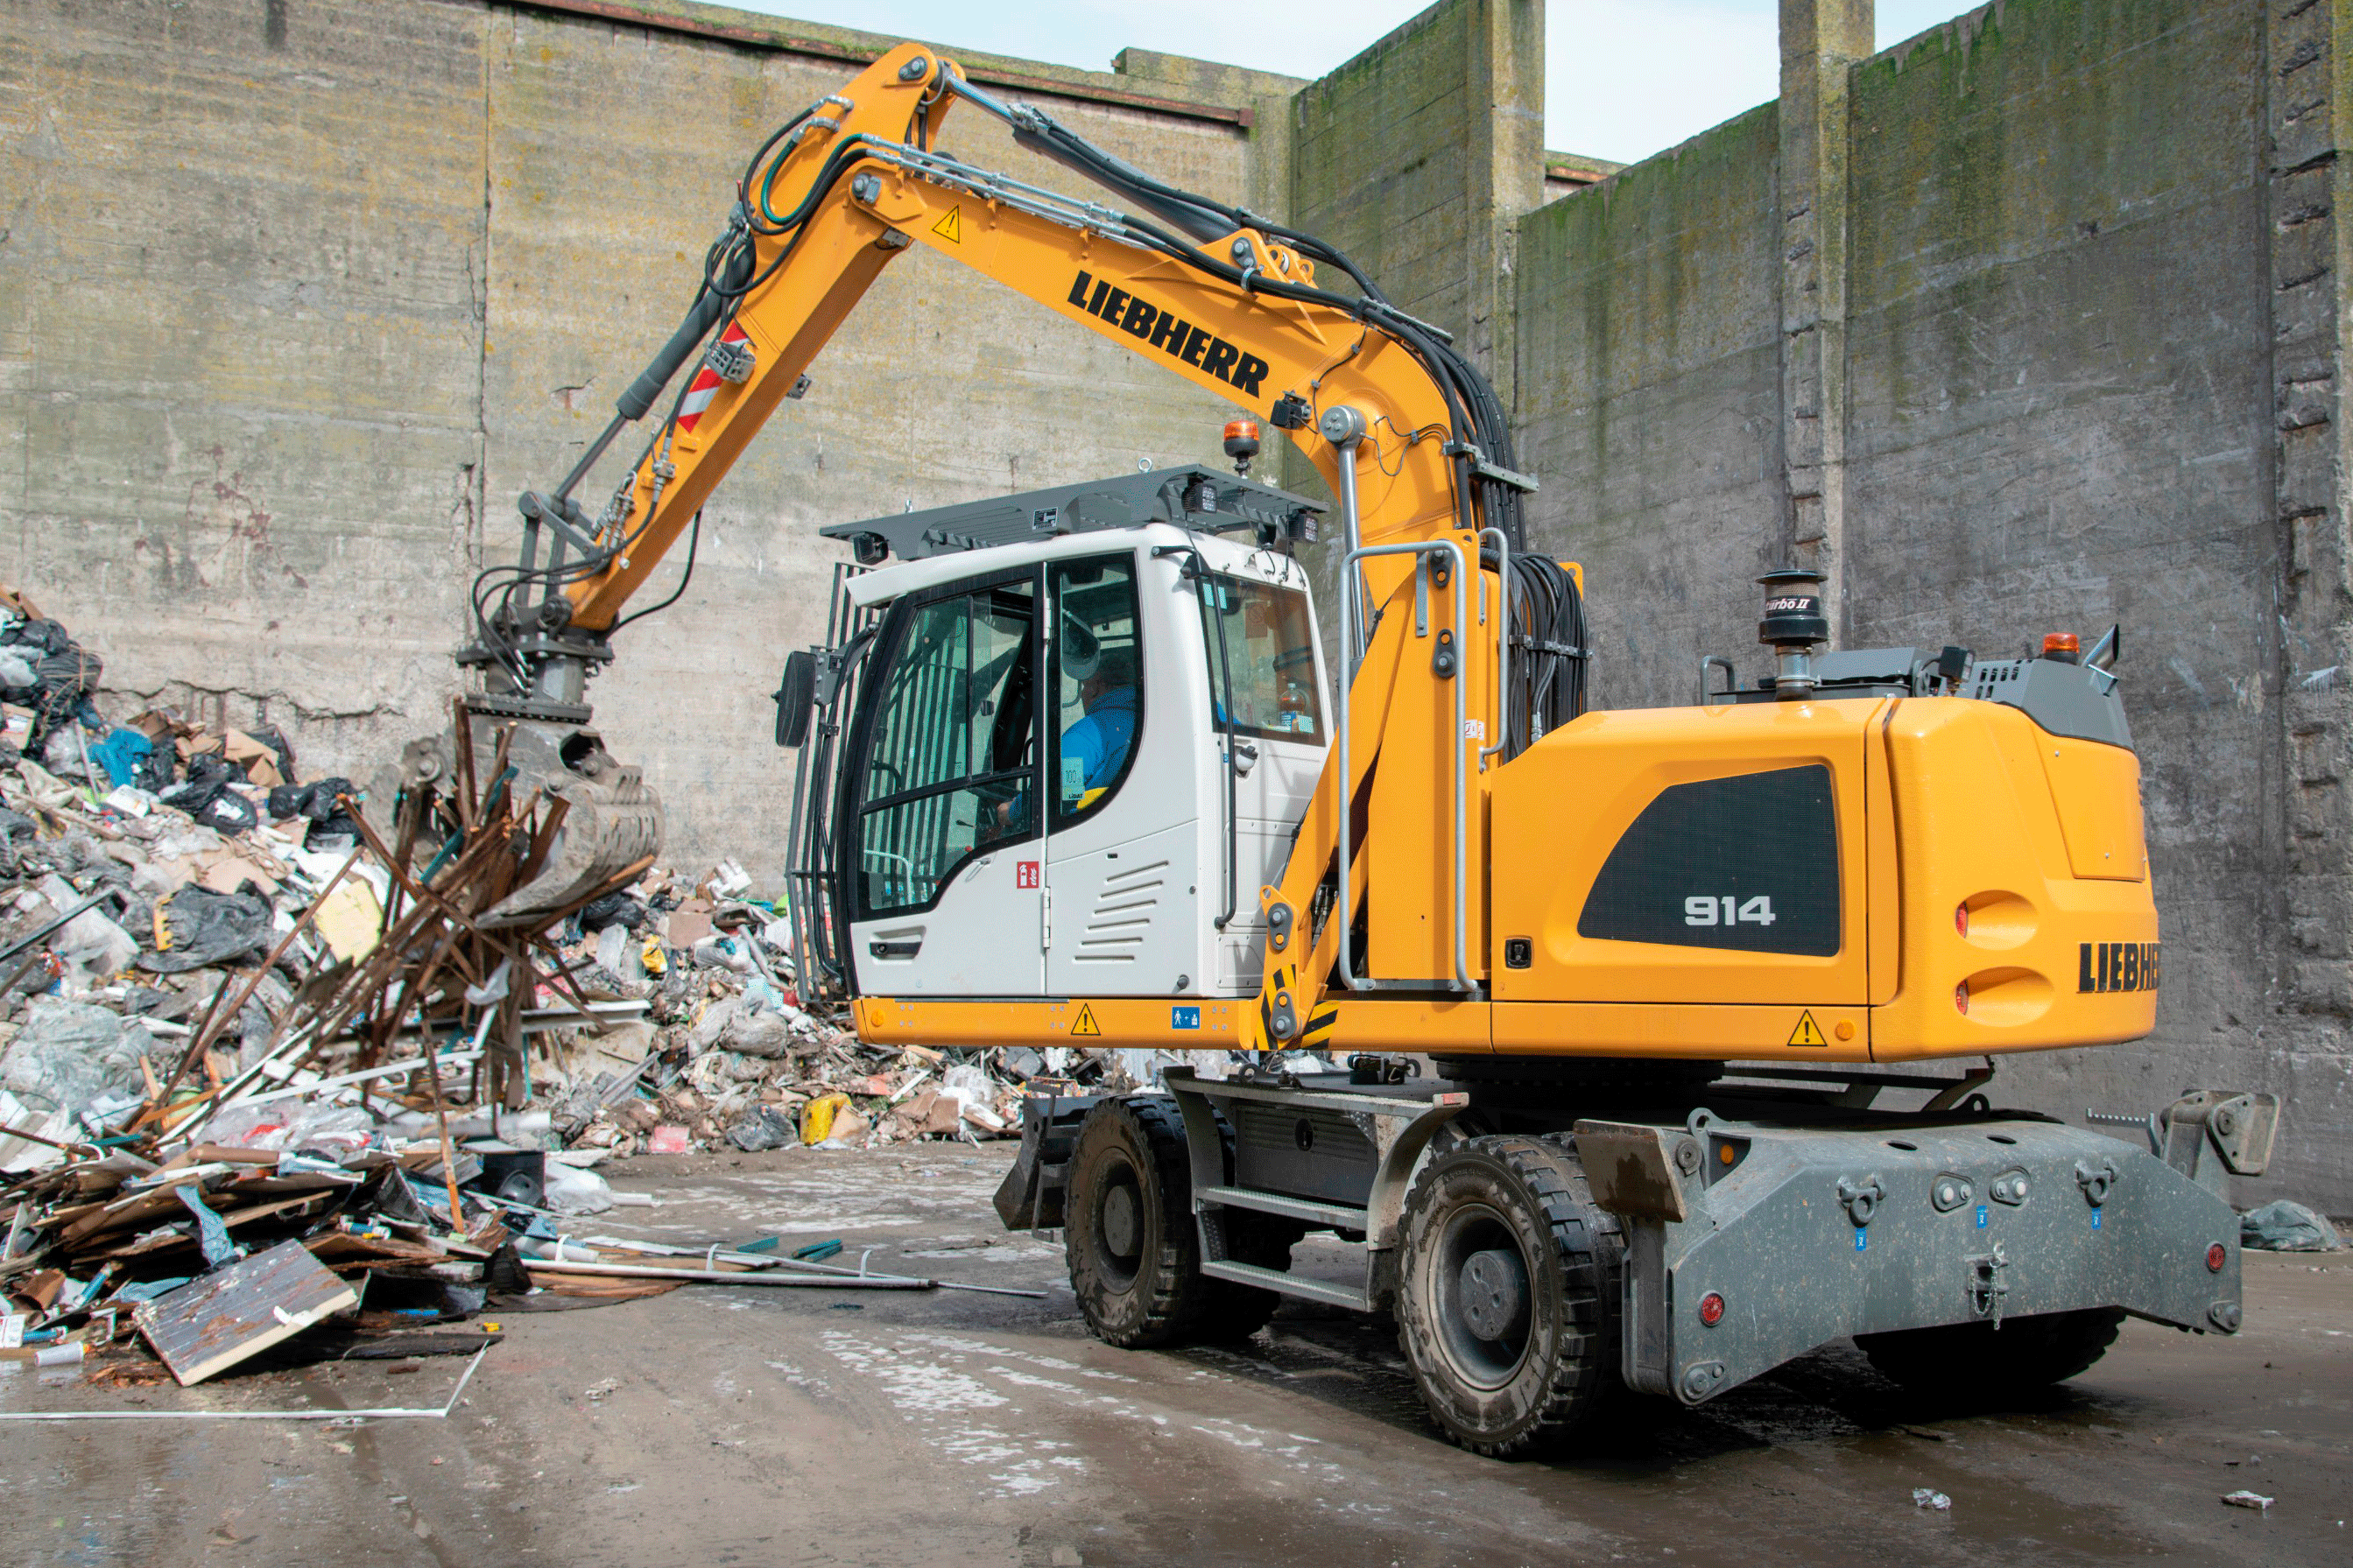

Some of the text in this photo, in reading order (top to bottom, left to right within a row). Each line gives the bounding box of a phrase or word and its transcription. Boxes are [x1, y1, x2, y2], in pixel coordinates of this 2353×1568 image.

[1067, 270, 1269, 399] LIEBHERR
[1685, 896, 1776, 925] 914
[2079, 942, 2160, 992] LIEBHE
